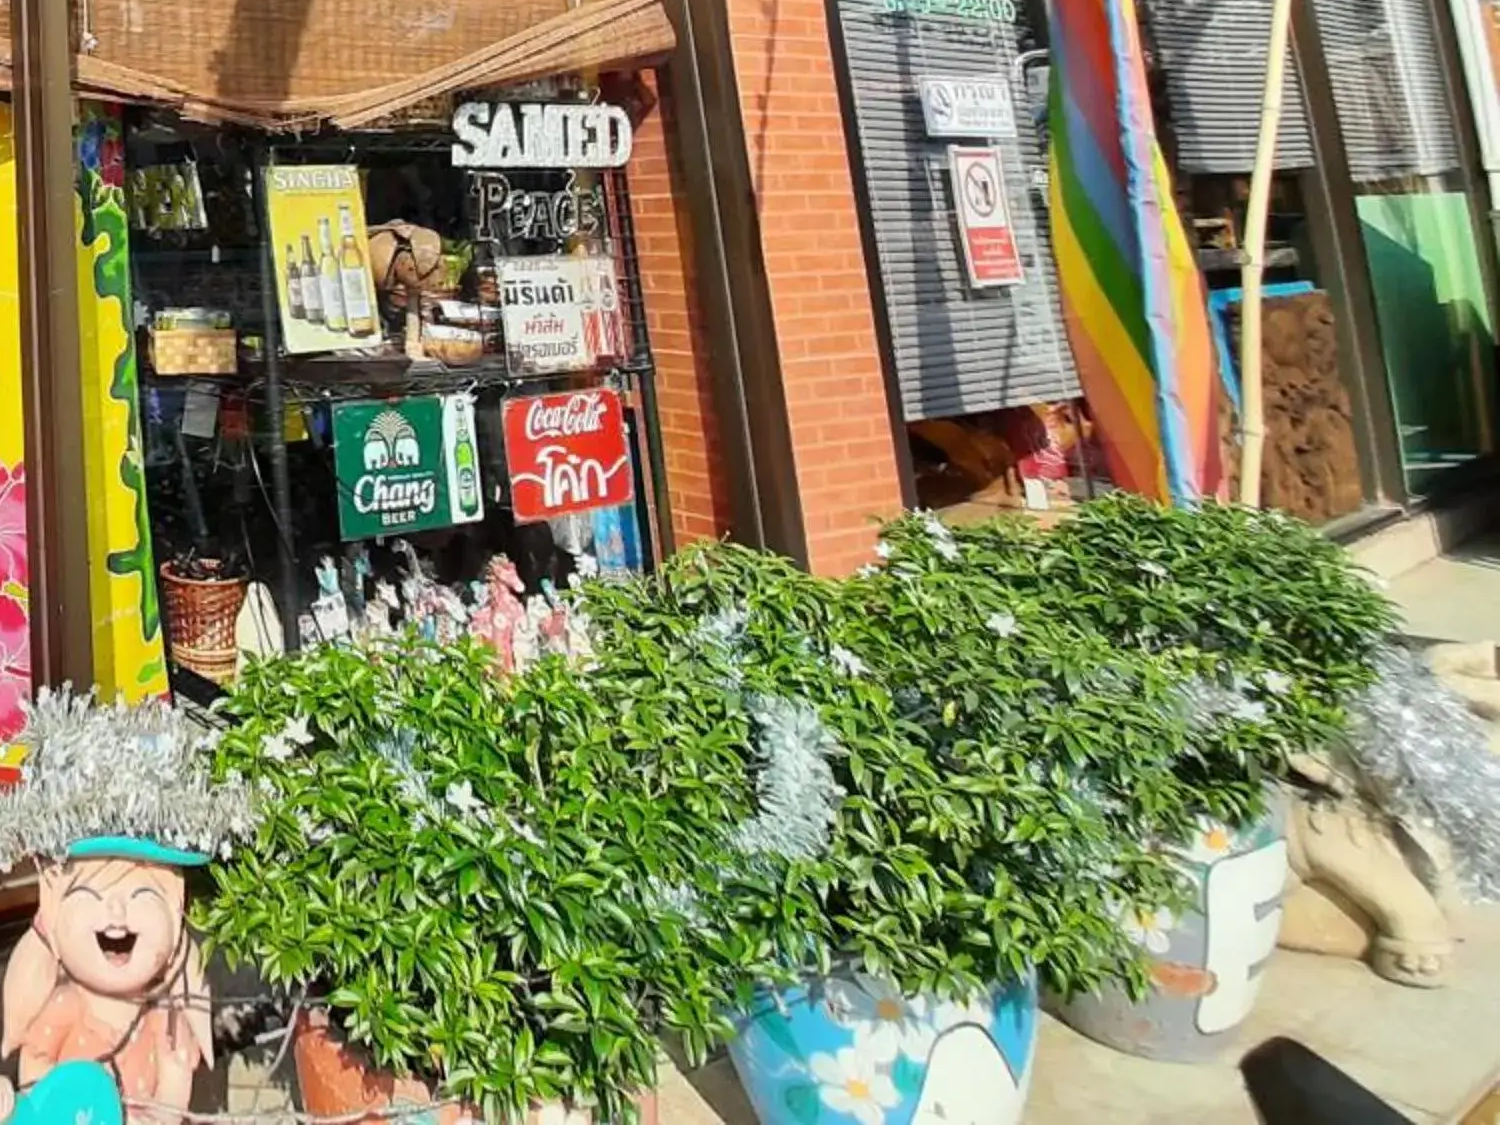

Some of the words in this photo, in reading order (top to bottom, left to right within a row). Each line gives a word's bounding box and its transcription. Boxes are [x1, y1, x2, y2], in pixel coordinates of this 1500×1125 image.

[452, 102, 632, 167] SAMED
[273, 169, 354, 191] SINGHA
[353, 474, 435, 514] Chang
[381, 508, 417, 526] BEER
